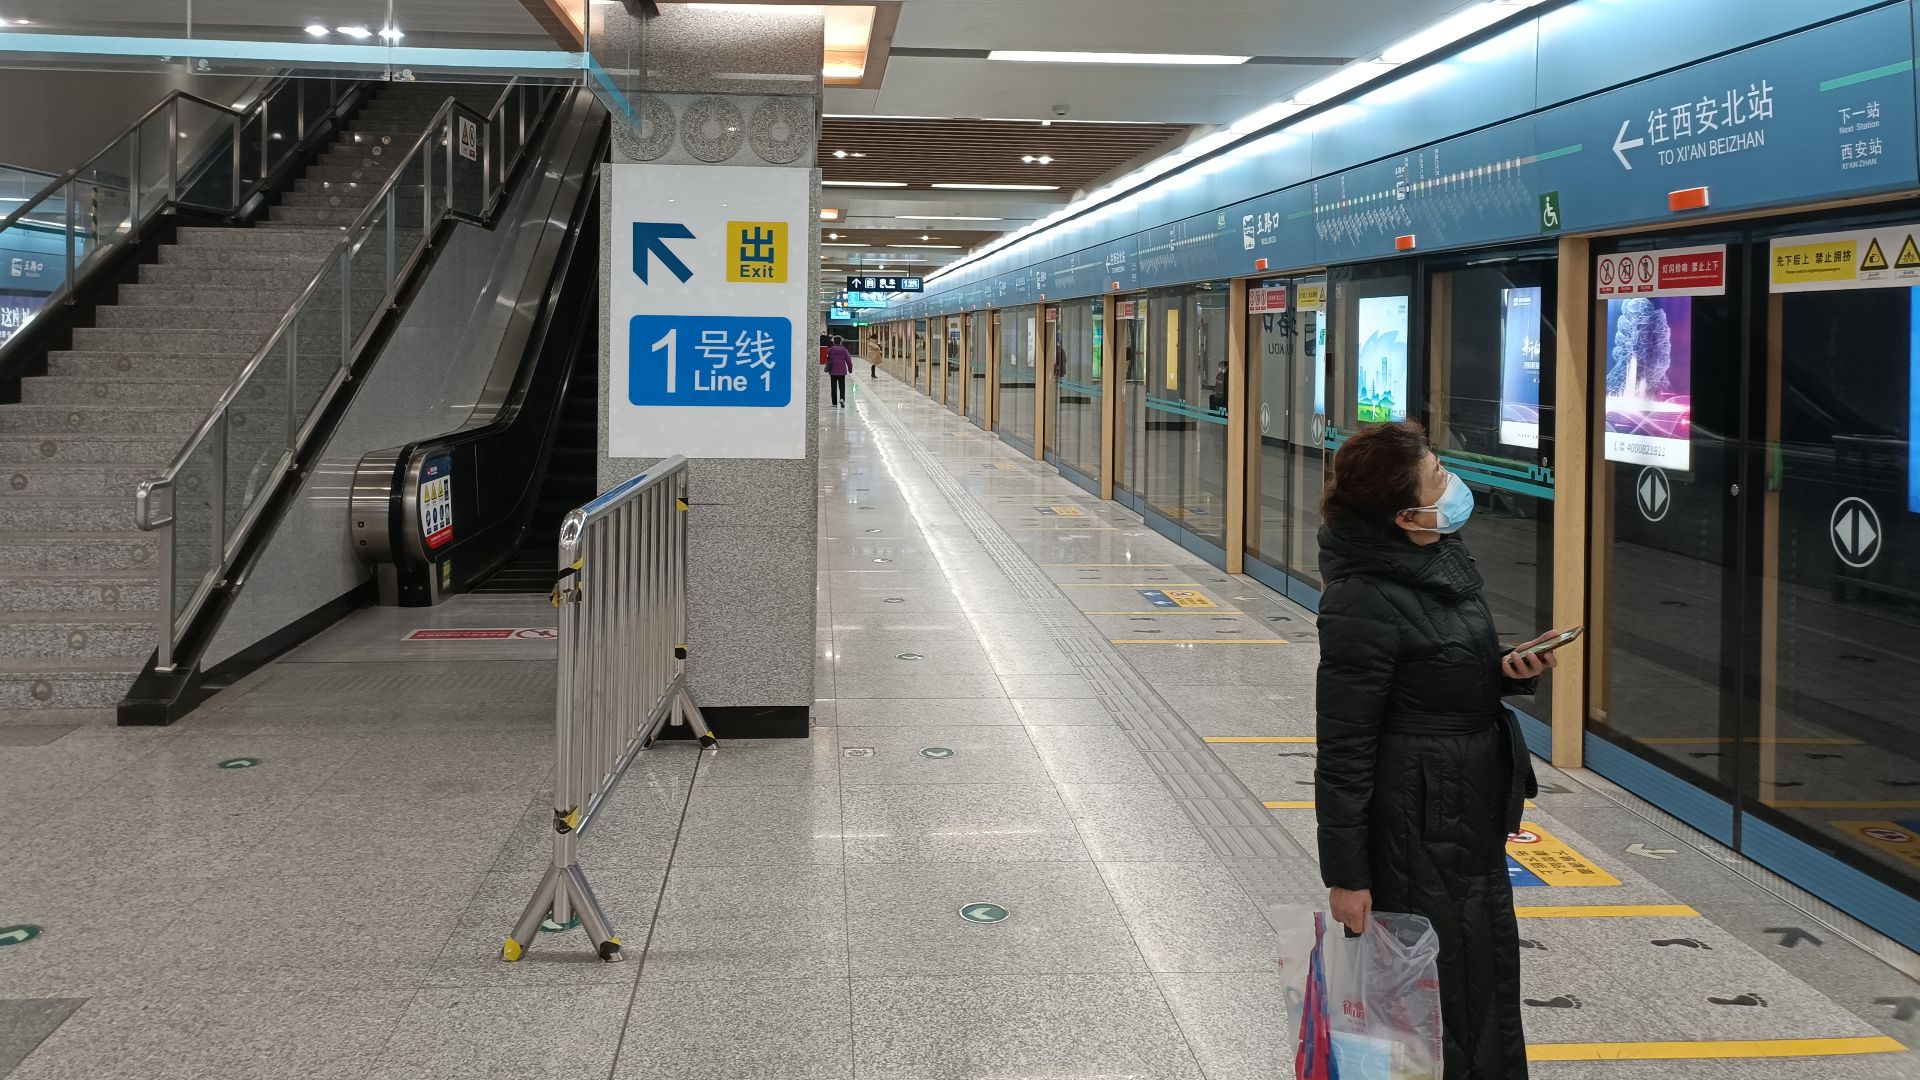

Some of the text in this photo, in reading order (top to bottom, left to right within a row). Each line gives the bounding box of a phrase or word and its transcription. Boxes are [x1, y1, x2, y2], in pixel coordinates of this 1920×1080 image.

[1647, 79, 1774, 146] 往西安北站
[1838, 100, 1880, 125] 下一站
[1856, 120, 1880, 131] Station
[1658, 129, 1765, 166] TO XI'AN BEIZHAN
[1840, 137, 1882, 161] 西安站
[740, 226, 774, 264] 出
[740, 265, 774, 279] Exit
[1776, 253, 1810, 268] 先下后上
[694, 370, 771, 391] Line 1
